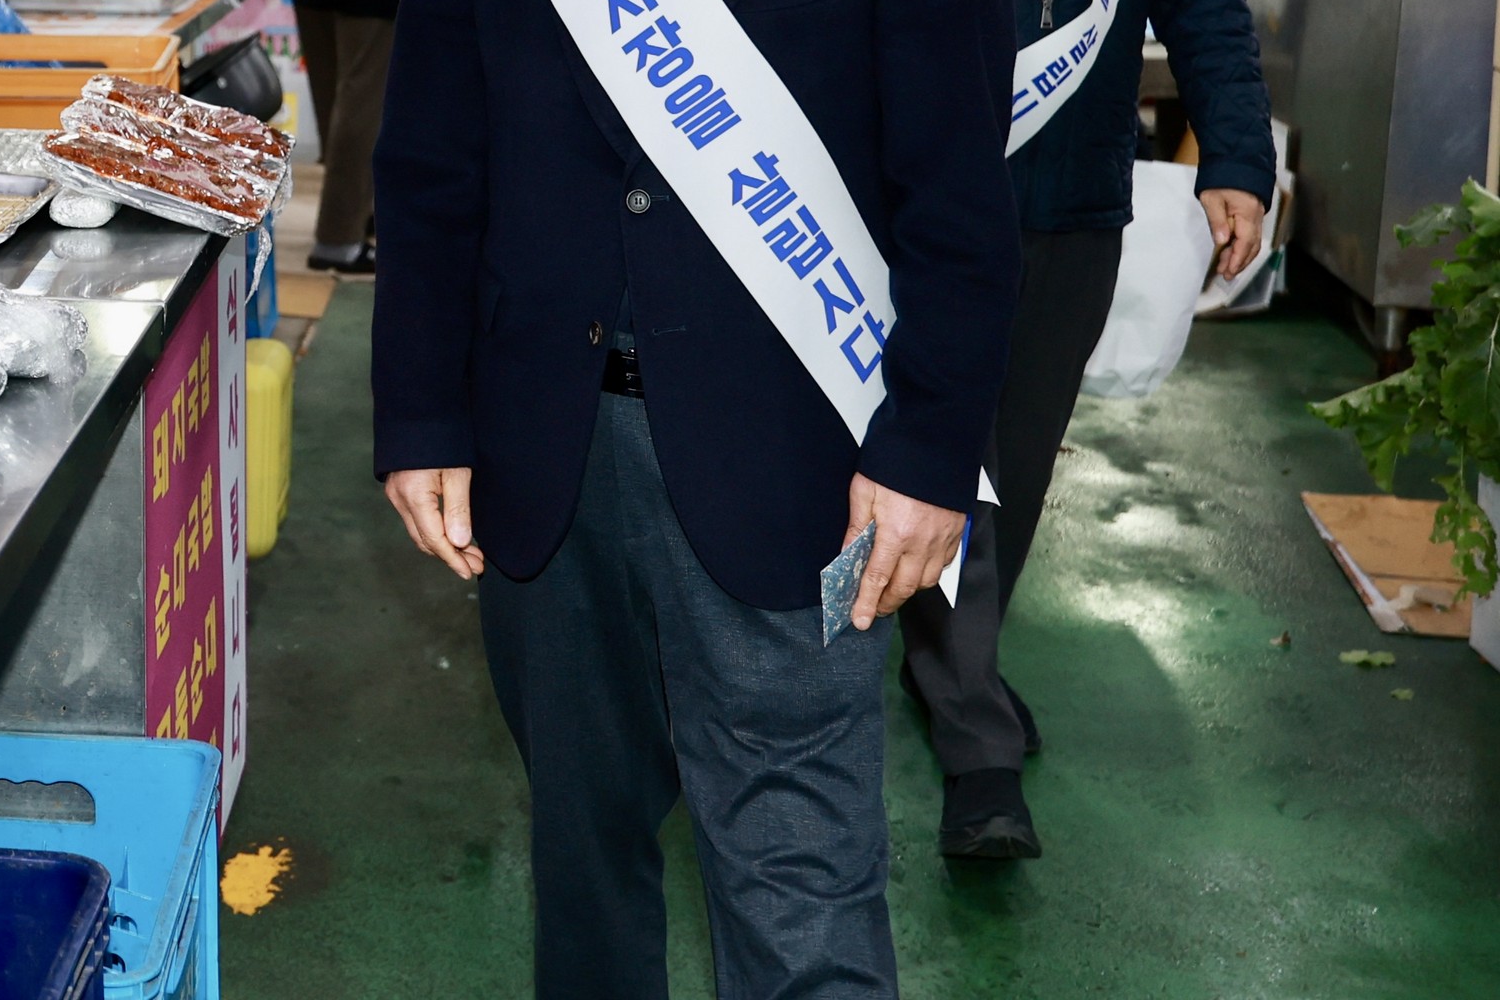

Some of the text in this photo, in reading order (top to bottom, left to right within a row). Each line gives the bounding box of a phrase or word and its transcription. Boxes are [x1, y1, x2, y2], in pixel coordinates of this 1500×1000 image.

[728, 151, 891, 385] 살립시다
[152, 330, 212, 504] 돼지국밥
[153, 463, 214, 660] 순대국밥
